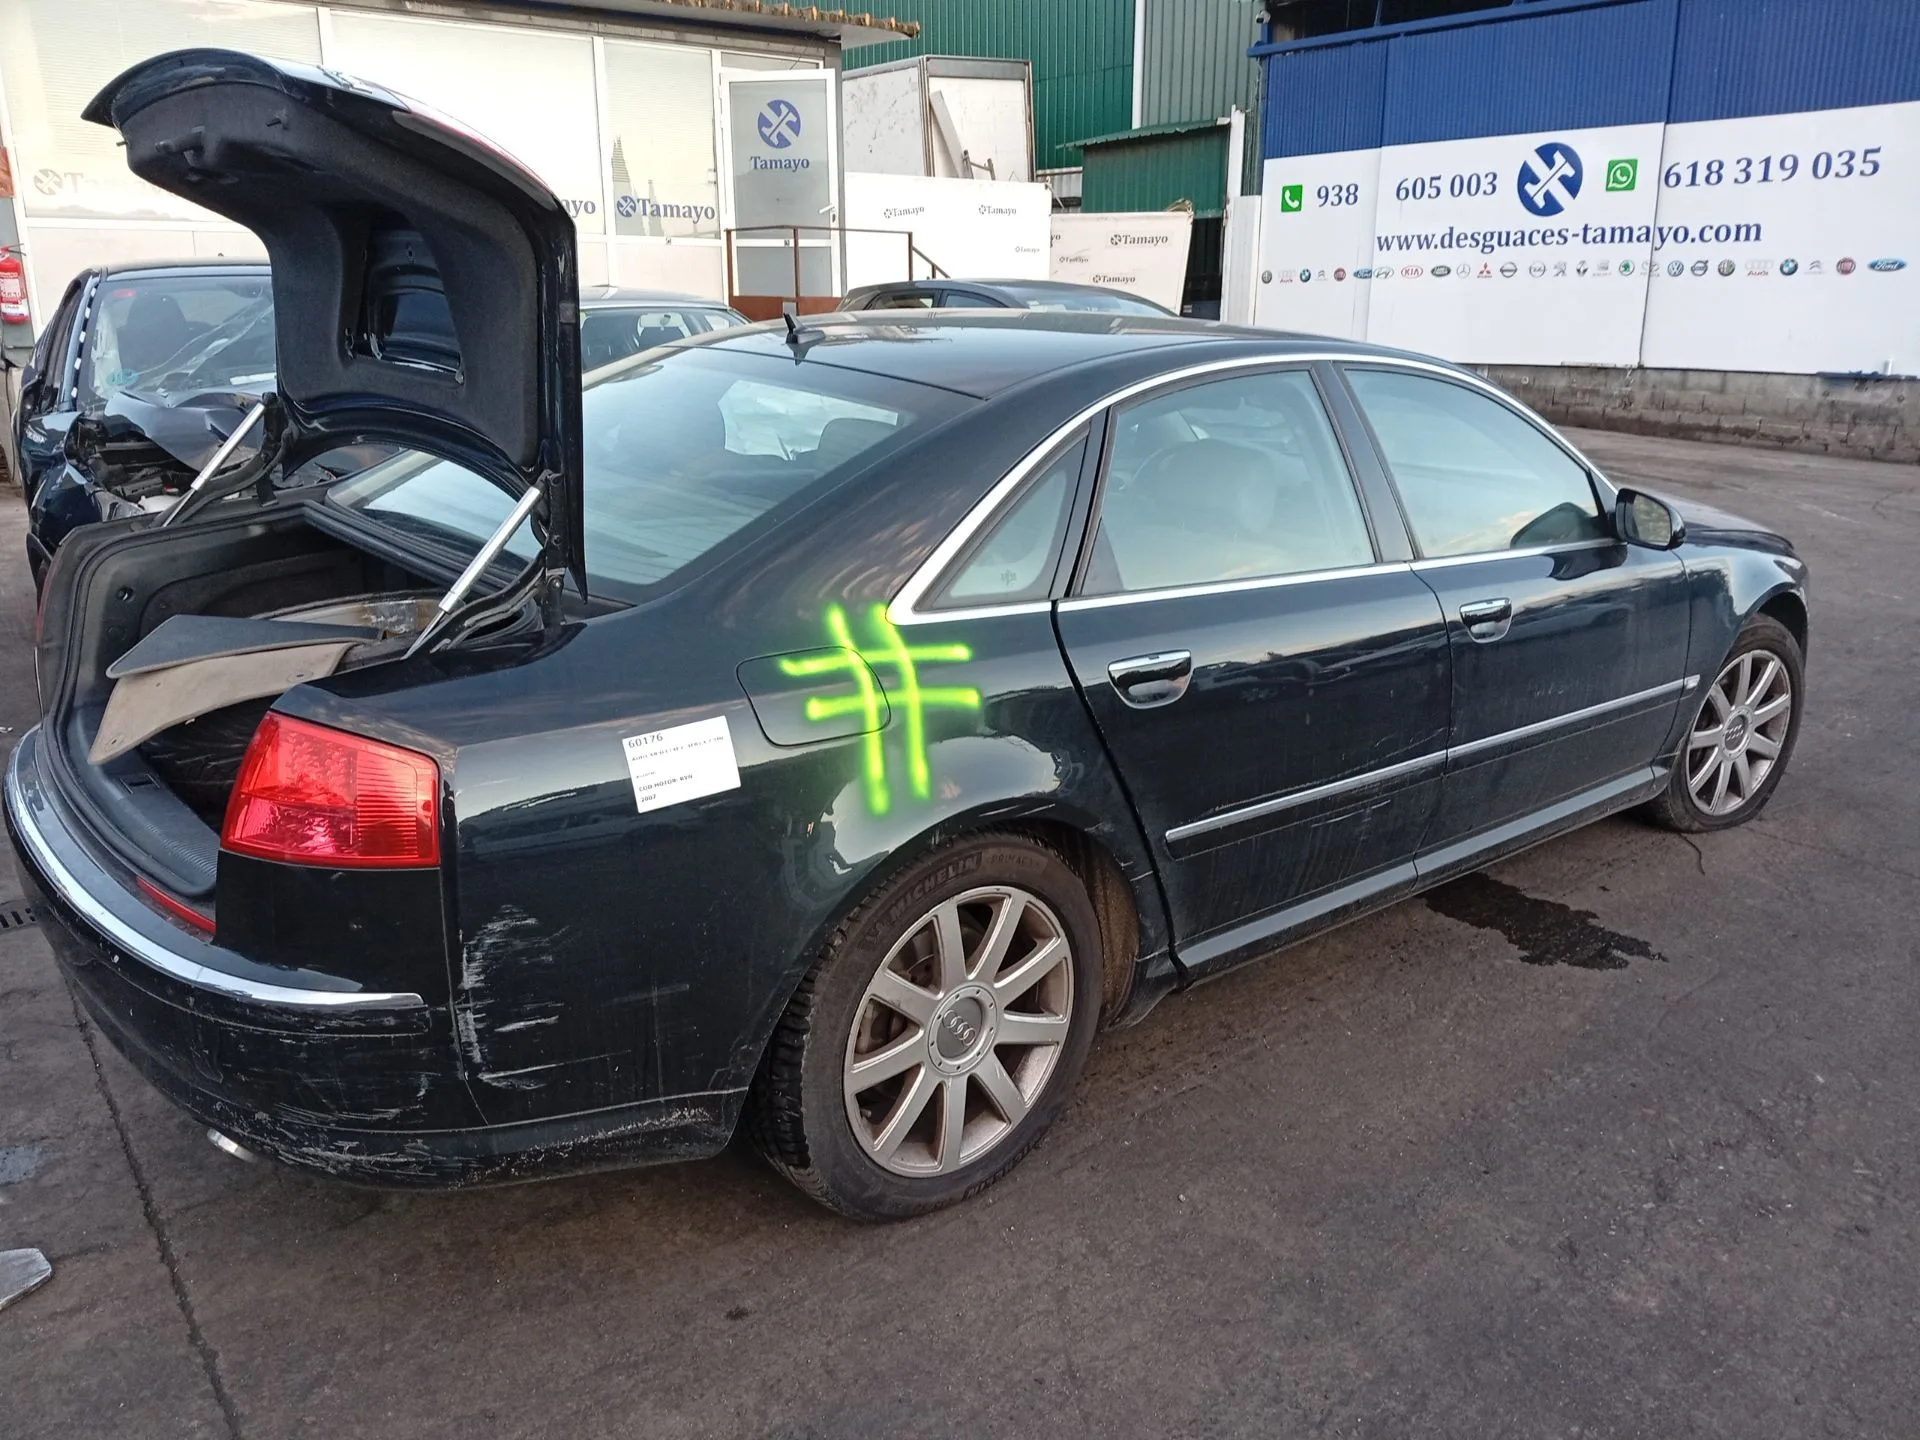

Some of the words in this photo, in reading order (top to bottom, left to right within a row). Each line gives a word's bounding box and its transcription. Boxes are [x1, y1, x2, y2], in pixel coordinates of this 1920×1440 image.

[750, 156, 810, 173] Tamayo
[1663, 159, 1725, 188] 618
[1733, 154, 1800, 184] 319
[1811, 146, 1882, 180] 035
[1316, 183, 1359, 207] 938
[1395, 174, 1442, 201] 605
[1450, 171, 1498, 198] 003
[637, 199, 716, 224] Tamayo
[893, 206, 925, 217] Tamayo
[987, 205, 1017, 216] Tamayo
[1122, 234, 1169, 246] Tamayo
[1376, 221, 1763, 255] www.desguaces-tamayo.com
[1101, 274, 1136, 283] Tamayo
[1403, 267, 1422, 277] KIA
[629, 733, 663, 748] 60176
[889, 854, 980, 919] MICHELIN
